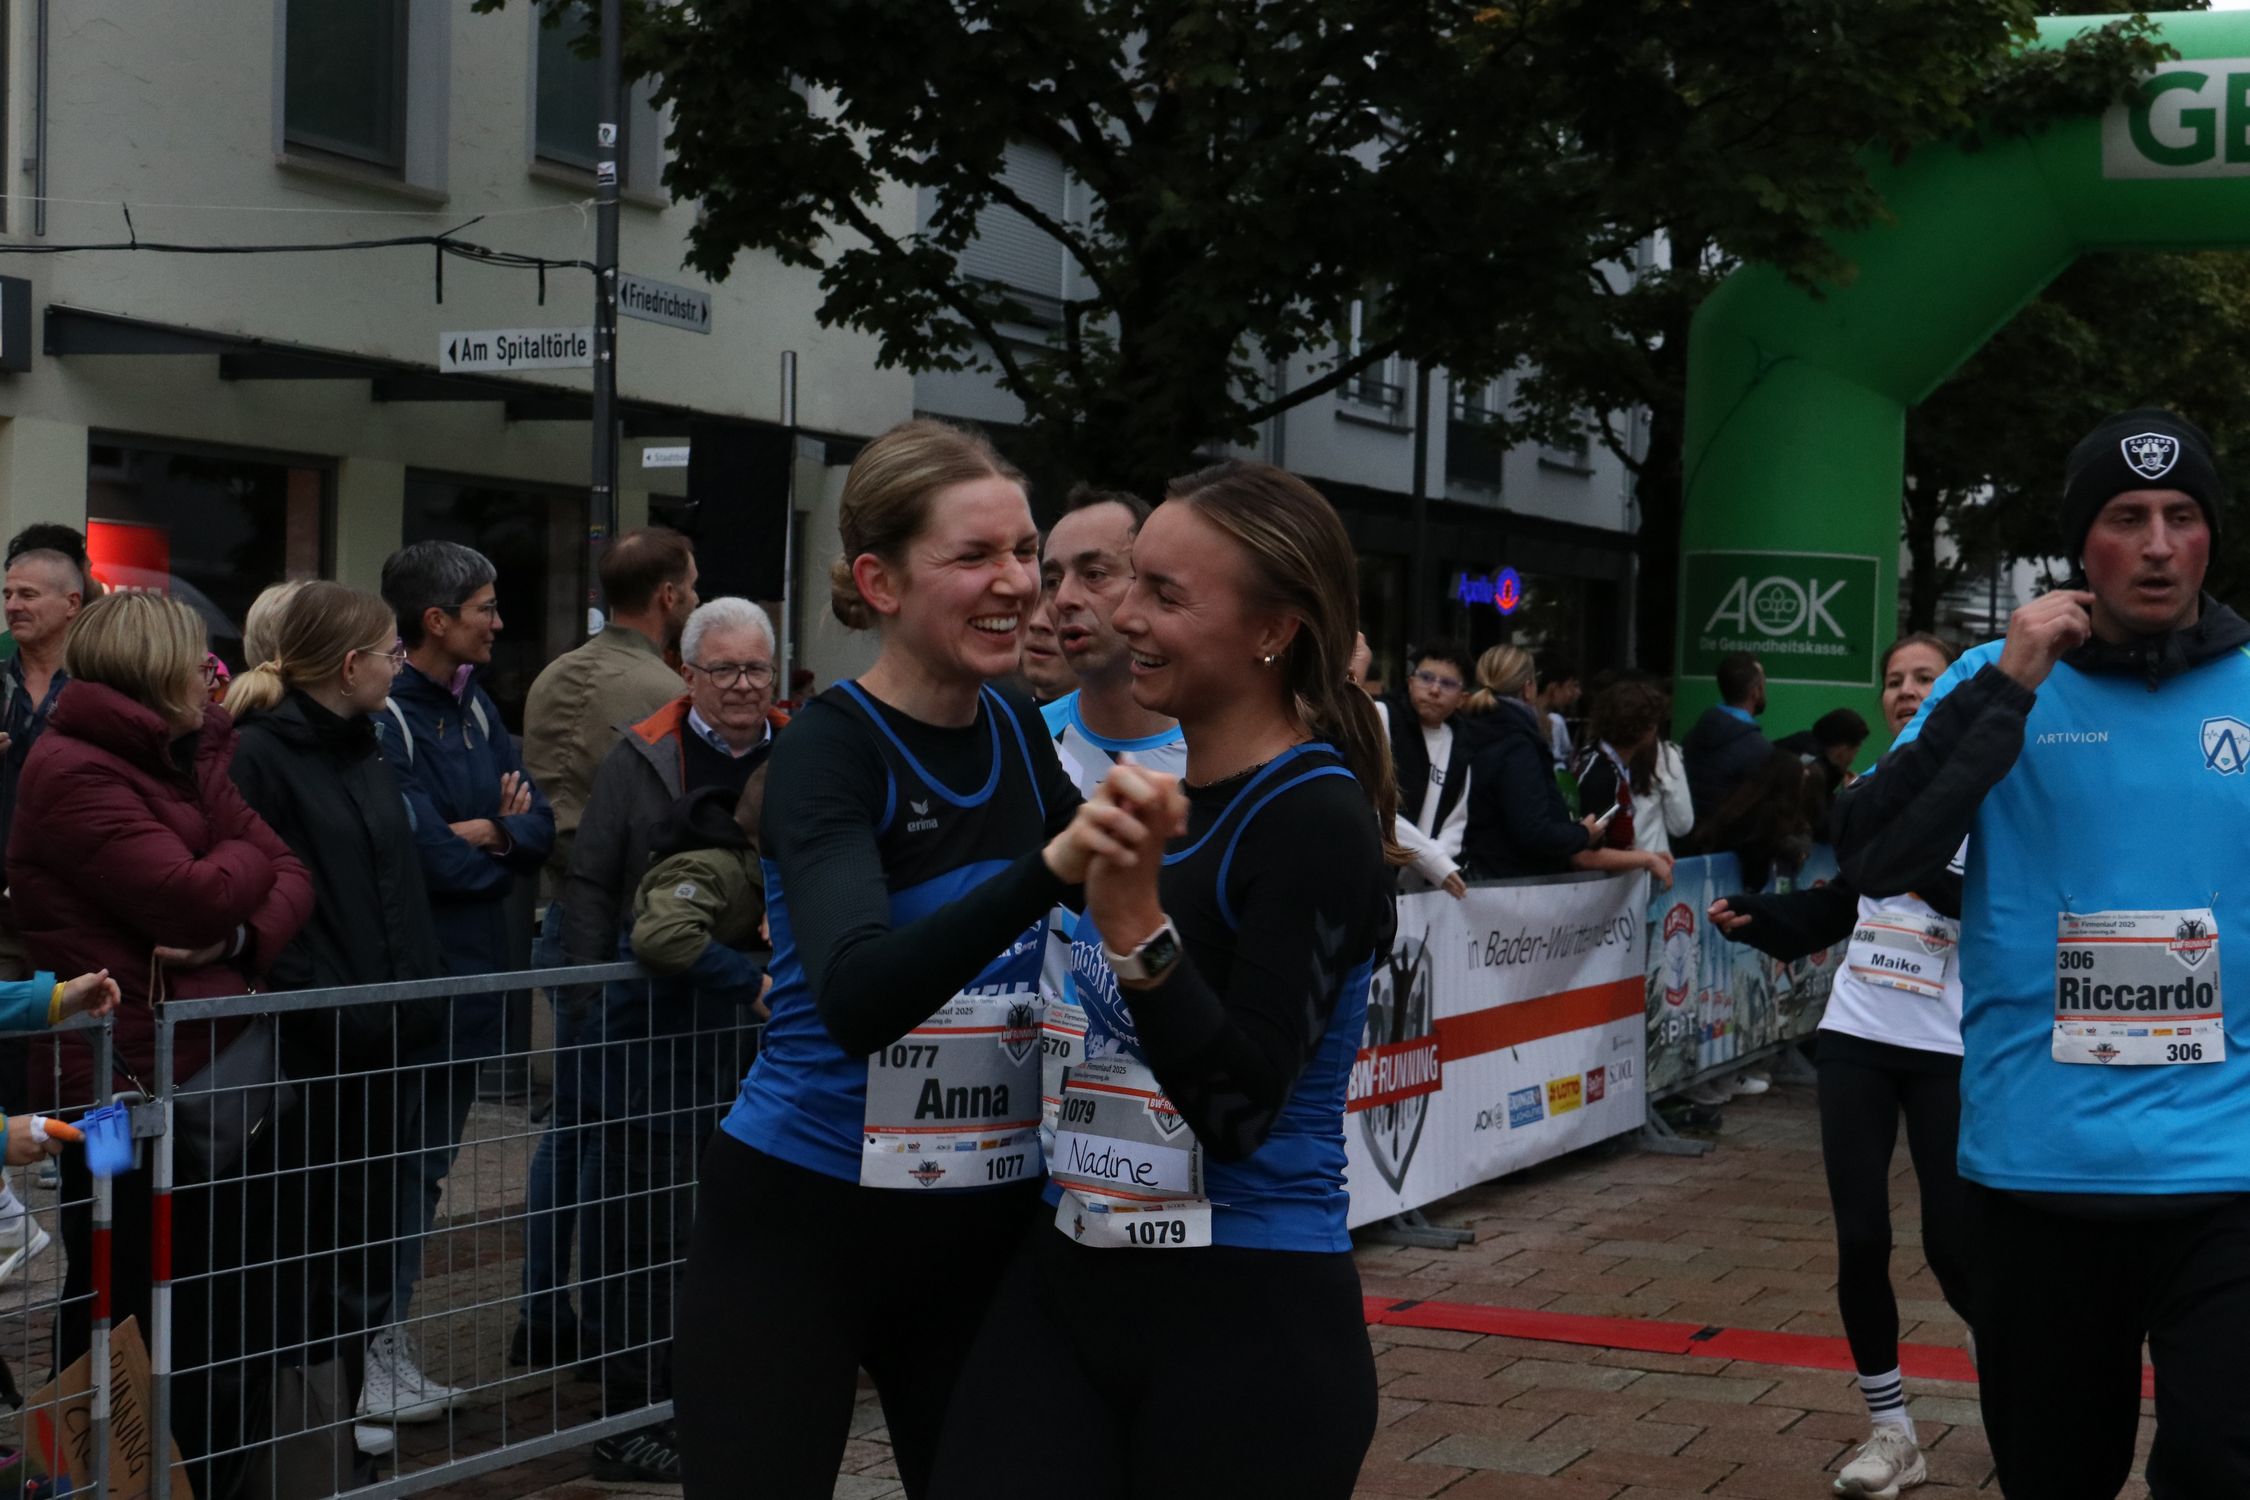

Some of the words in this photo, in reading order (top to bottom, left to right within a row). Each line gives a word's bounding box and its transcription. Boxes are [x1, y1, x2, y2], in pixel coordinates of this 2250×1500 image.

[629, 284, 698, 322] Friedrichstr.
[461, 338, 487, 362] Am
[496, 333, 587, 366] Spitaltörle
[1704, 575, 1848, 639] AOK
[1700, 636, 1717, 650] Die
[1719, 636, 1850, 656] Gesundheitskasse.
[2036, 731, 2109, 745] ARTIVION
[907, 818, 939, 833] erima
[1467, 930, 1480, 970] in
[1484, 907, 1637, 967] Baden-Württerg!
[1854, 930, 1876, 943] 936
[1871, 953, 1921, 974] Maike
[2059, 951, 2094, 969] 306
[2059, 976, 2213, 1011] Riccardo
[879, 1045, 939, 1068] 1077
[2167, 1043, 2203, 1062] 306
[1348, 1044, 1438, 1100] BW-RUNNING
[914, 1079, 1009, 1120] Anna
[1062, 1098, 1096, 1124] 1079
[986, 1154, 1024, 1181] 1077
[1068, 1137, 1159, 1186] Nadine
[1125, 1220, 1186, 1245] 1079
